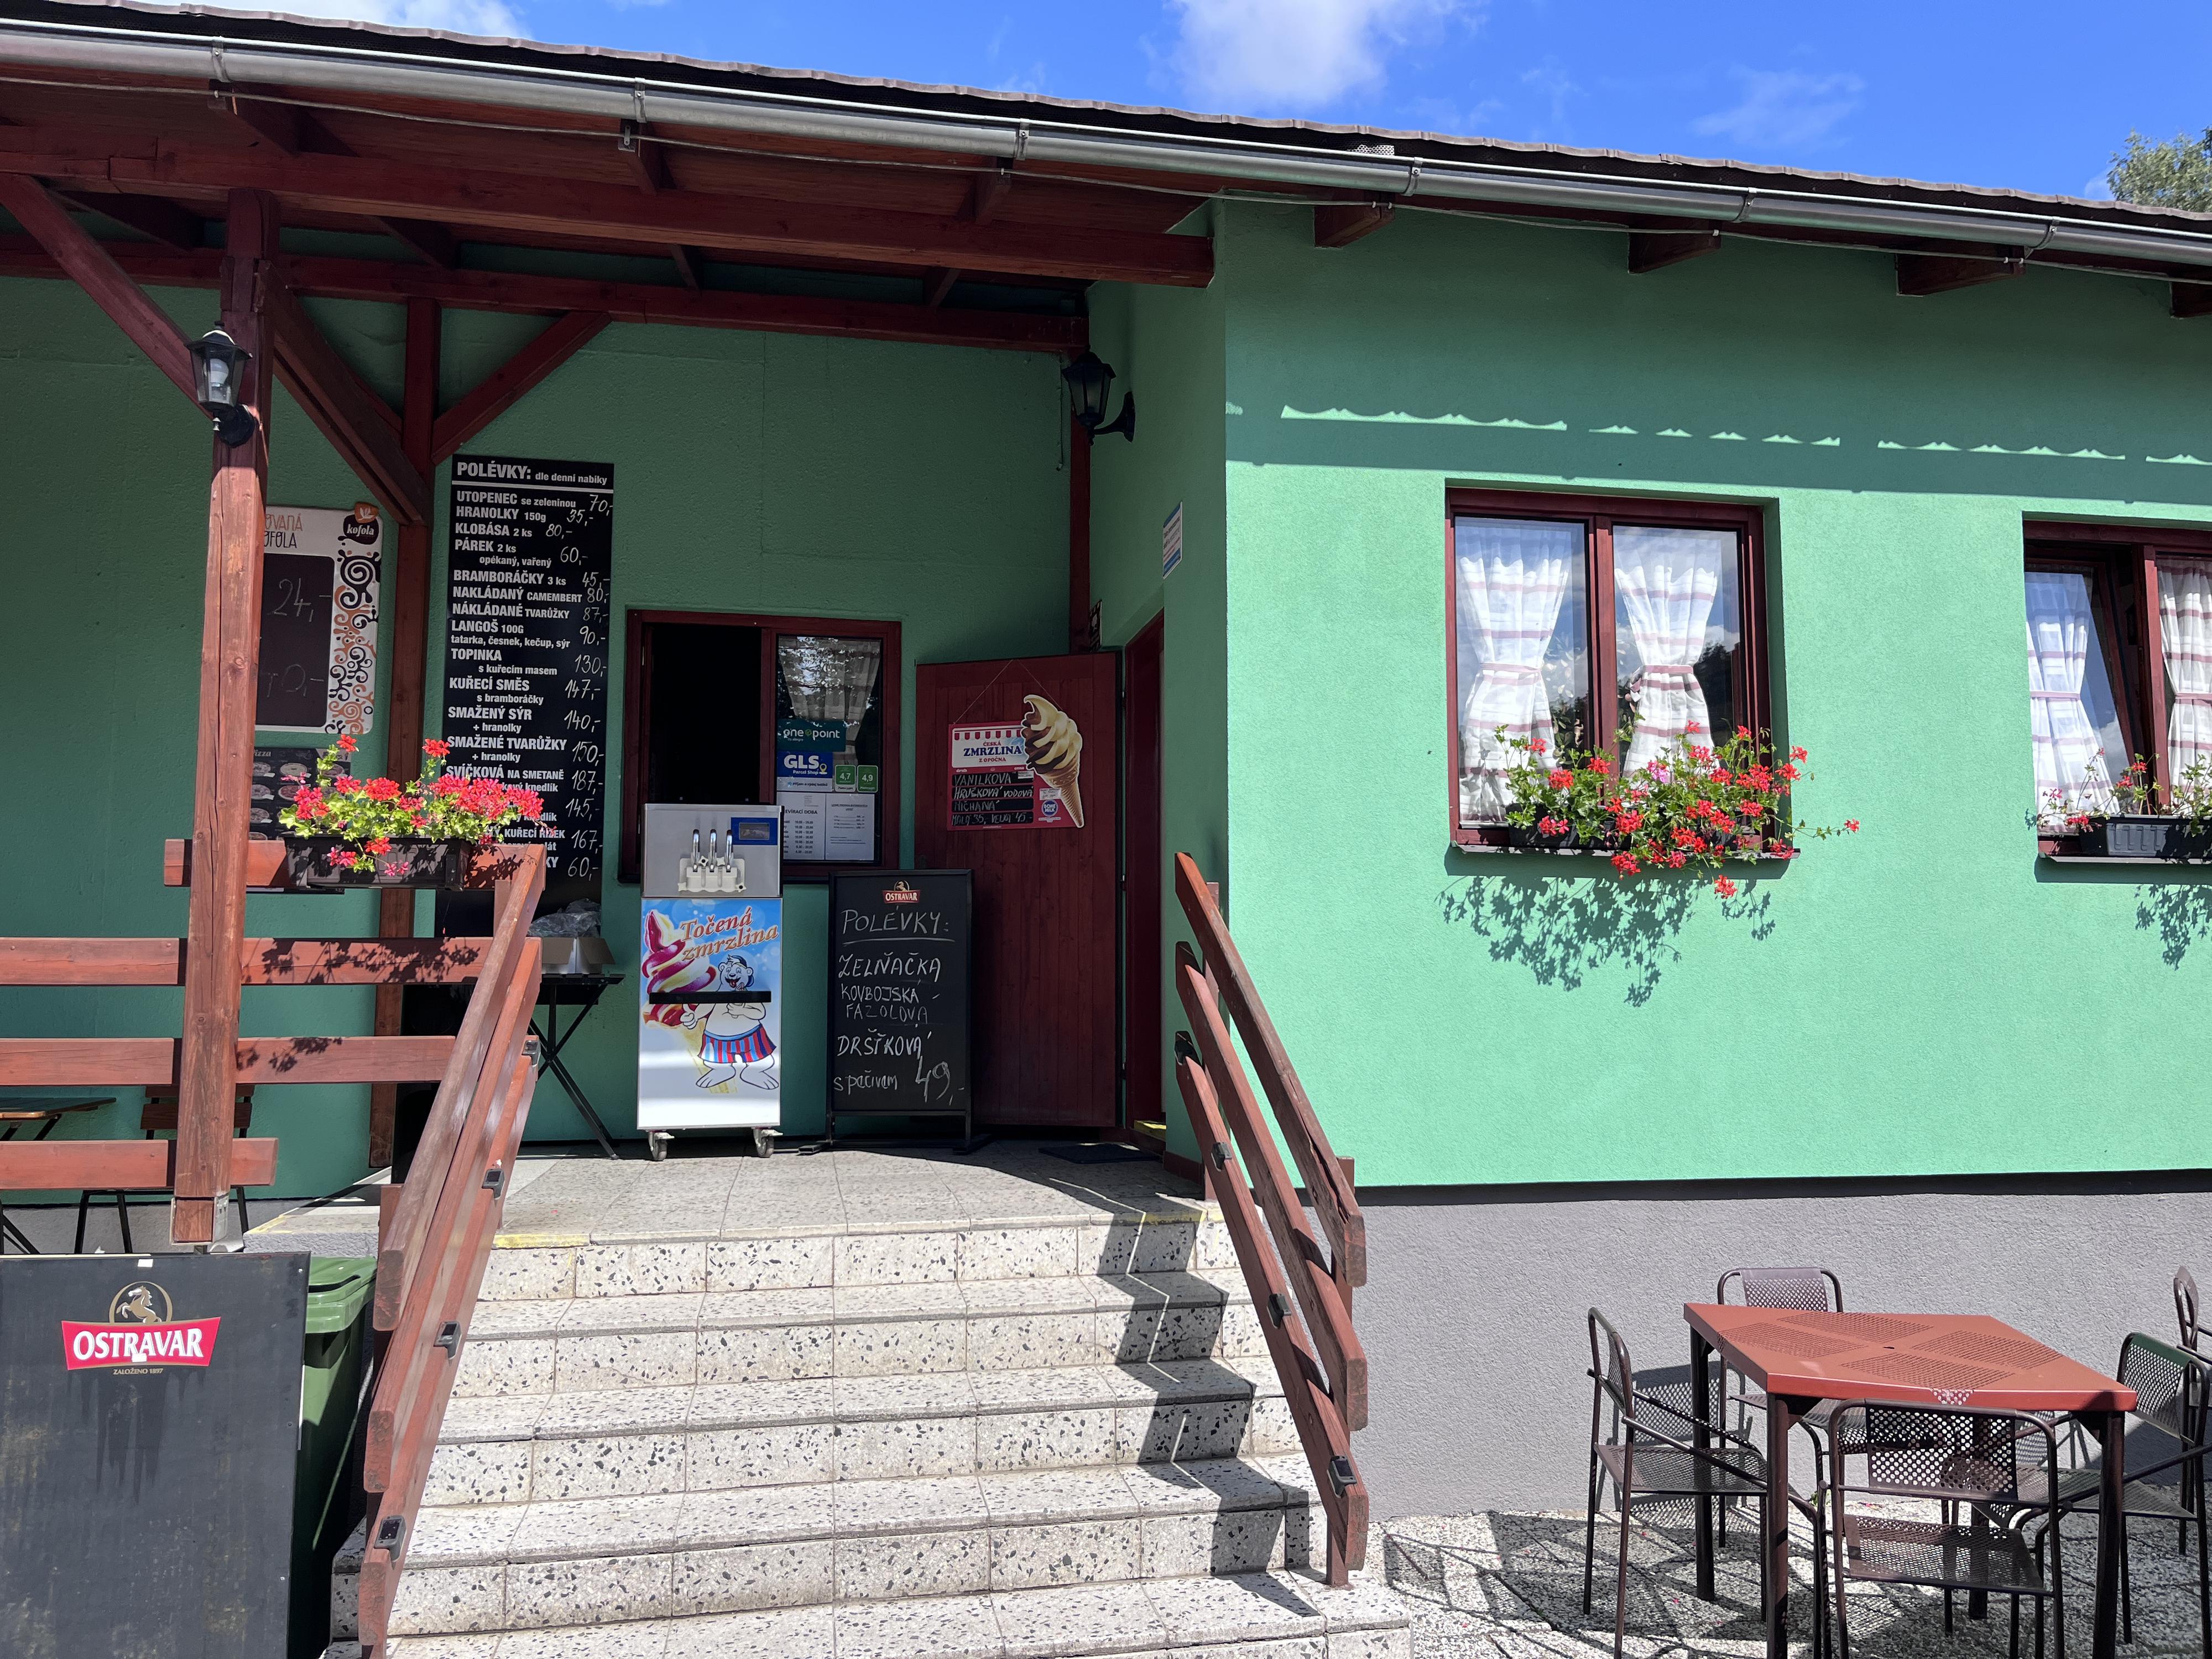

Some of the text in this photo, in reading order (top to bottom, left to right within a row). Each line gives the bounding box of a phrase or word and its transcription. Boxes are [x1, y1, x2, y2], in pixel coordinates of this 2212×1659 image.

[457, 460, 531, 479] POLÉVKY:
[535, 473, 549, 481] dle
[551, 474, 575, 482] denní
[457, 491, 517, 504] UTOPENEC
[534, 498, 576, 508] zeleninou
[589, 494, 613, 516] 70,-
[456, 507, 593, 526] HRANOLKY 150g 35,-
[264, 531, 297, 548] OFOLA
[347, 524, 374, 537] kofola
[456, 521, 510, 536] KLOBÁSA
[522, 529, 532, 537] ks
[546, 524, 572, 539] 80,-
[455, 539, 494, 552] PÁREK
[479, 546, 588, 568] opékaný, vařený 60,-
[453, 568, 544, 585] BRAMBORÁČKY
[582, 572, 611, 588] 45,-
[453, 586, 609, 603] NAKLÁDANÝ CAMEMBERT 80,-
[525, 607, 570, 619] TVARŮŽKY
[582, 607, 608, 622] 87,-
[452, 618, 498, 633] LANGOŠ
[451, 626, 606, 649] tatarka, česnek, kečup, sýr 90,-
[451, 648, 502, 661] TOPINKA
[486, 664, 523, 674] kuřecím
[575, 654, 607, 677] 130,-
[450, 676, 601, 700] KUŘECÍ SMĚS 147,-
[485, 693, 544, 705] bramboráčky
[448, 706, 601, 732] SMAŽENÝ SÝR 140,-
[482, 723, 521, 734] hranolky
[784, 729, 840, 740] one point
[447, 735, 604, 766] SMAŽENÉ TVARŮŽKY 150,-
[481, 752, 520, 763] hranolky
[963, 745, 1021, 757] ZMRZLINA
[784, 755, 819, 769] GLS
[446, 764, 504, 778] SVÍČKOVÁ
[523, 769, 564, 779] SMETANĚ
[572, 770, 603, 794] 187,-
[839, 773, 851, 781] 4,7
[954, 786, 1003, 799] HRUŠKOVÁ
[566, 799, 600, 821] 145,-
[504, 827, 536, 837] KUŘECÍ
[571, 830, 603, 854] 167,-
[568, 857, 598, 881] 60,-
[885, 892, 918, 902] OSTRAVAR
[680, 906, 753, 942] Točená
[841, 906, 949, 935] POLÉVKY:
[681, 924, 779, 962] zmrzlina
[838, 951, 941, 983] ZELŇAČKA
[841, 979, 921, 1004] KOVBOJSKÁ
[837, 1028, 932, 1060] DRŠŤKOVÁ
[915, 1056, 964, 1106] 49,-
[73, 1327, 204, 1361] OSTRAVAR
[113, 1367, 148, 1375] ZALOŽENO
